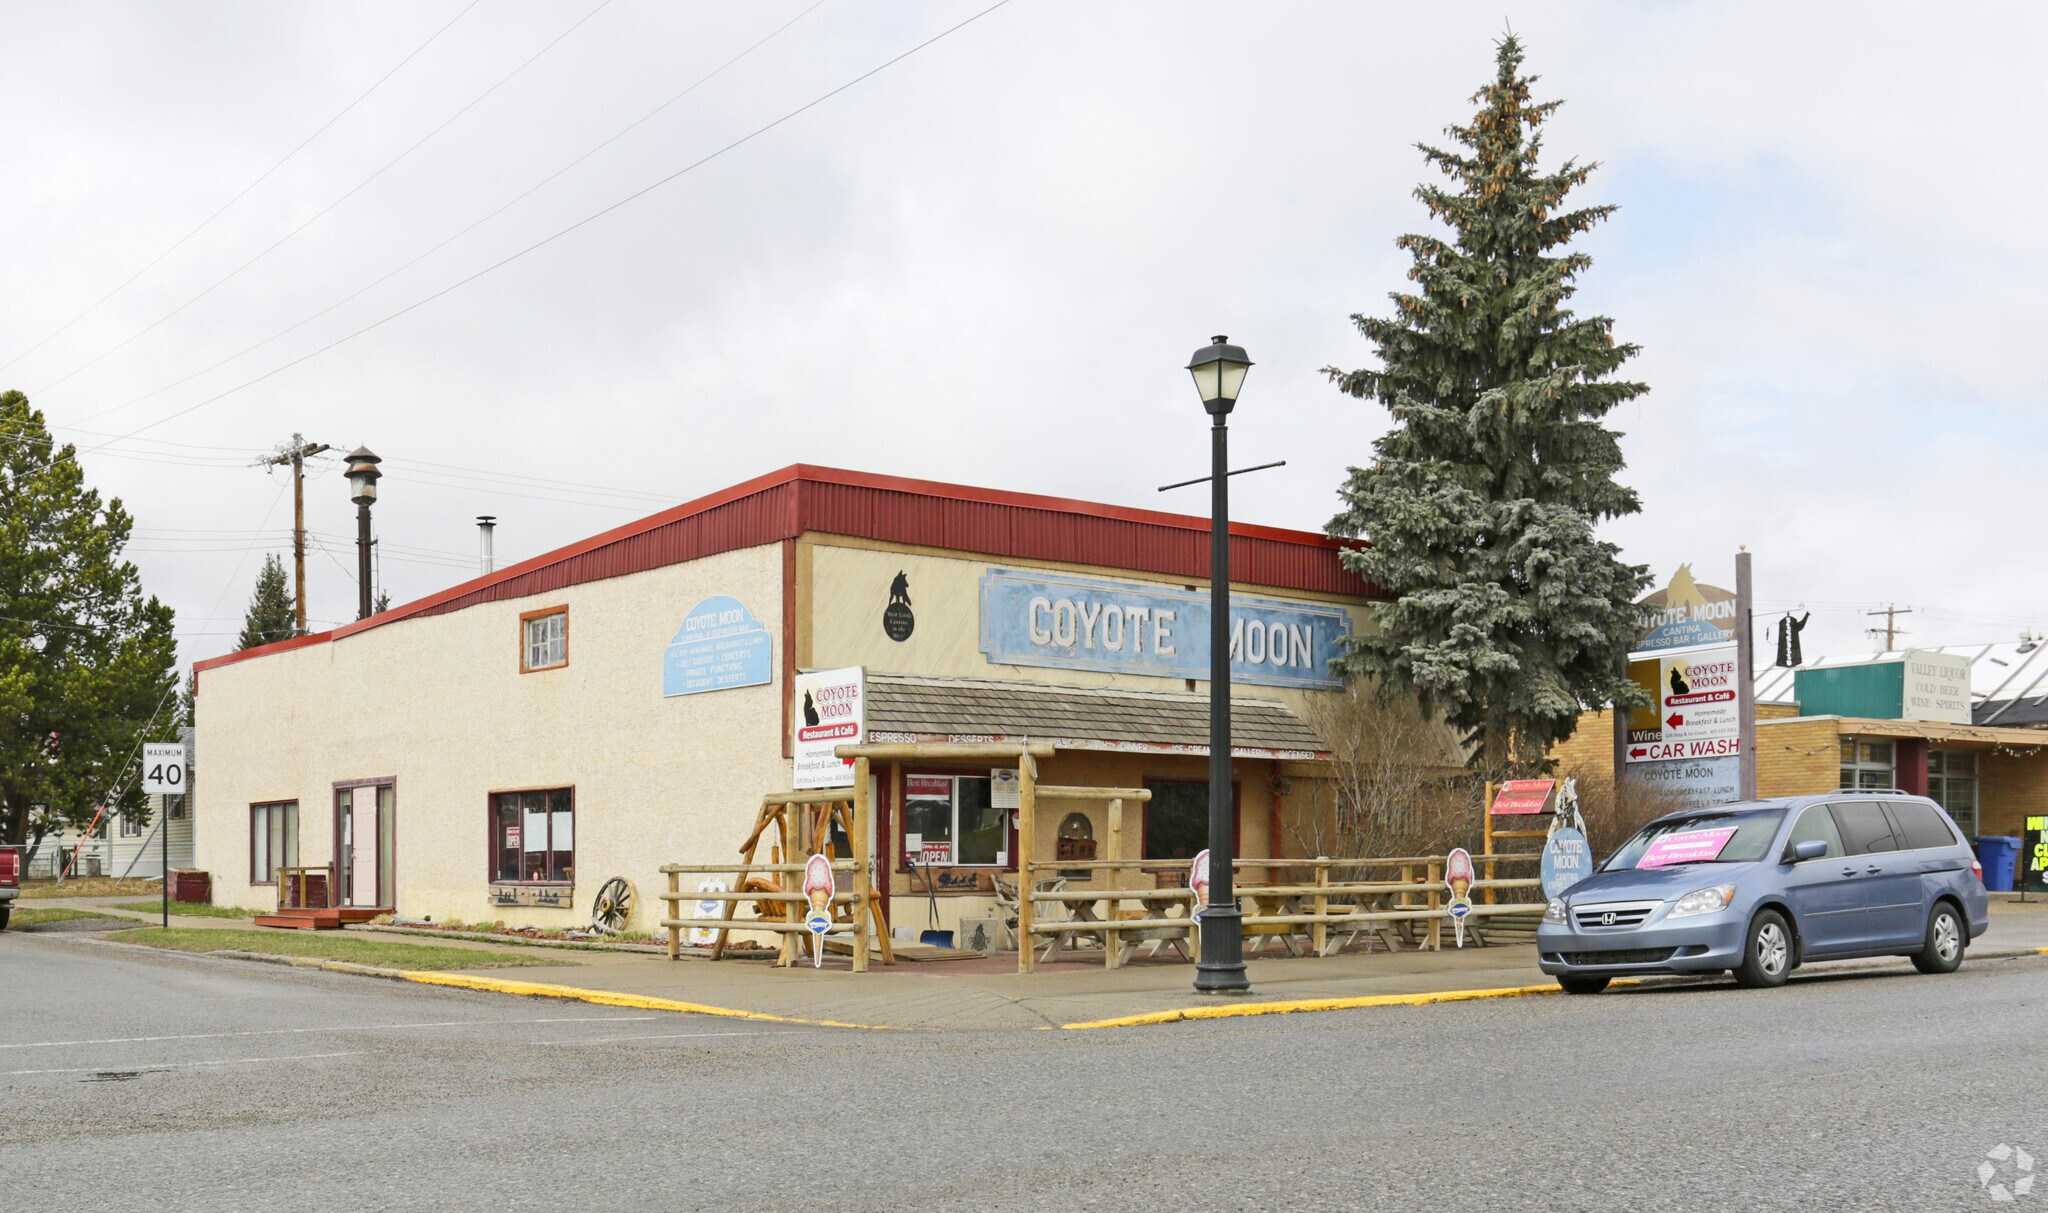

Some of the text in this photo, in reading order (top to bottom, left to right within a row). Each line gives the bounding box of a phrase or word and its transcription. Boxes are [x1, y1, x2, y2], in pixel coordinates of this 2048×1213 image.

[686, 608, 744, 631] COYOTE MOON
[1637, 599, 1737, 628] OYOTE MOON
[1029, 596, 1177, 656] COYOTE
[1663, 624, 1701, 636] CANTINA
[1674, 635, 1690, 645] BAR
[1697, 629, 1735, 642] GALLERY
[721, 650, 752, 661] CONCERTS
[1685, 662, 1734, 677] COYOTE
[1911, 663, 1966, 682] VALLEY LIQUOR
[717, 673, 747, 684] DESSERTS
[1691, 676, 1728, 688] MOON
[816, 685, 858, 702] COYOTE
[1916, 682, 1959, 696] COLD BEER
[1670, 695, 1706, 705] Restaurant
[1715, 692, 1730, 702] Café
[1911, 697, 1966, 711] WINE SPIRITS
[821, 702, 852, 718] MOON
[1686, 718, 1712, 727] Breakfast
[802, 726, 854, 740] Restaurant & Café
[1632, 730, 1662, 741] Wine
[869, 731, 917, 743] ESPRESSO
[948, 734, 994, 743] DESSERTS
[1234, 747, 1265, 757] GALLERY
[1650, 738, 1740, 759] CAR WASH
[147, 749, 182, 757] MAXIMUM
[805, 749, 833, 758] Homemade
[797, 760, 841, 771] Breakfast & Lunch
[148, 764, 182, 785] 40
[1645, 768, 1713, 781] COYOTE MOON
[907, 779, 948, 787] Best Breakfast
[1713, 786, 1735, 794] LUNCH
[1510, 800, 1542, 808] Breakfast
[1550, 840, 1583, 854] COYOTE
[922, 851, 949, 863] OPEN
[1668, 850, 1717, 860] Breakfast
[1554, 855, 1579, 869] MOON
